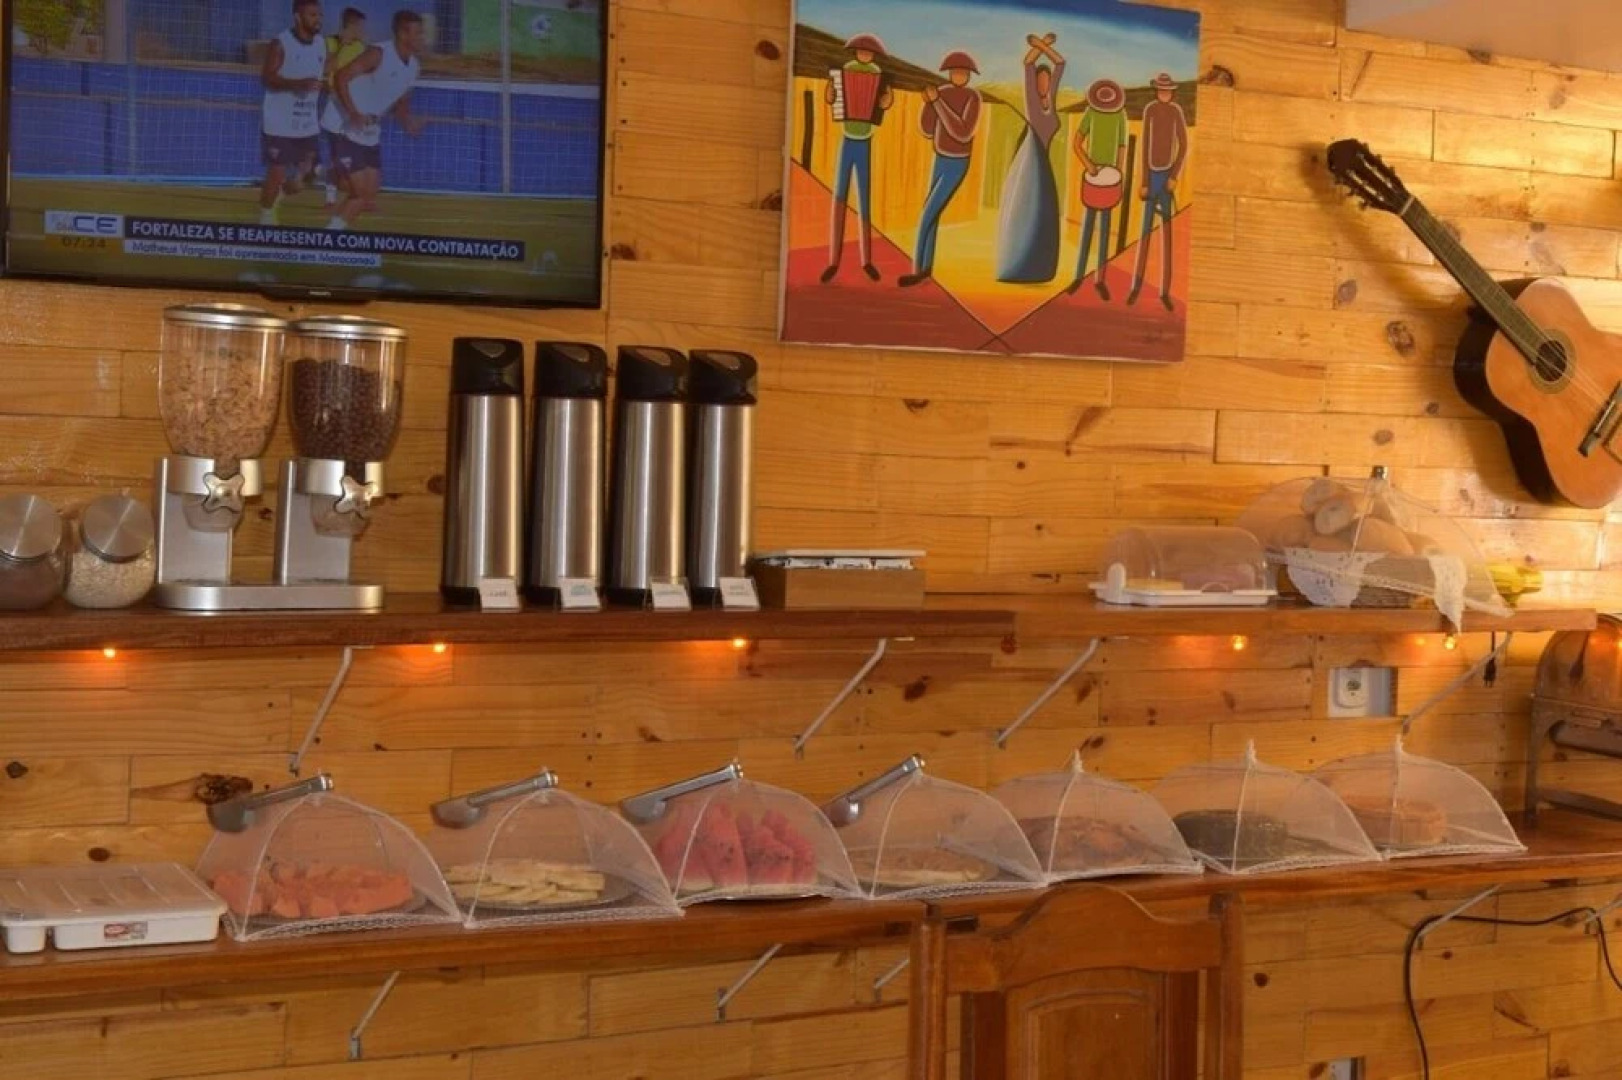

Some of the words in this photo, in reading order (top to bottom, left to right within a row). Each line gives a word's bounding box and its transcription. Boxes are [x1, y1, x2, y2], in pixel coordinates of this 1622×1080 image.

[73, 215, 118, 234] CE
[132, 221, 215, 240] FORTALEZA
[218, 226, 234, 241] SE
[239, 228, 333, 248] REAPRESENTA
[337, 233, 370, 249] COM
[374, 237, 415, 252] NOVA
[418, 239, 519, 260] CONTRATAÇÃO
[132, 241, 178, 253] Matheus
[180, 244, 217, 257] Vargas
[219, 247, 234, 257] foi
[235, 249, 297, 262] apresentado
[299, 252, 316, 262] em
[319, 252, 376, 266] Maracanaú
